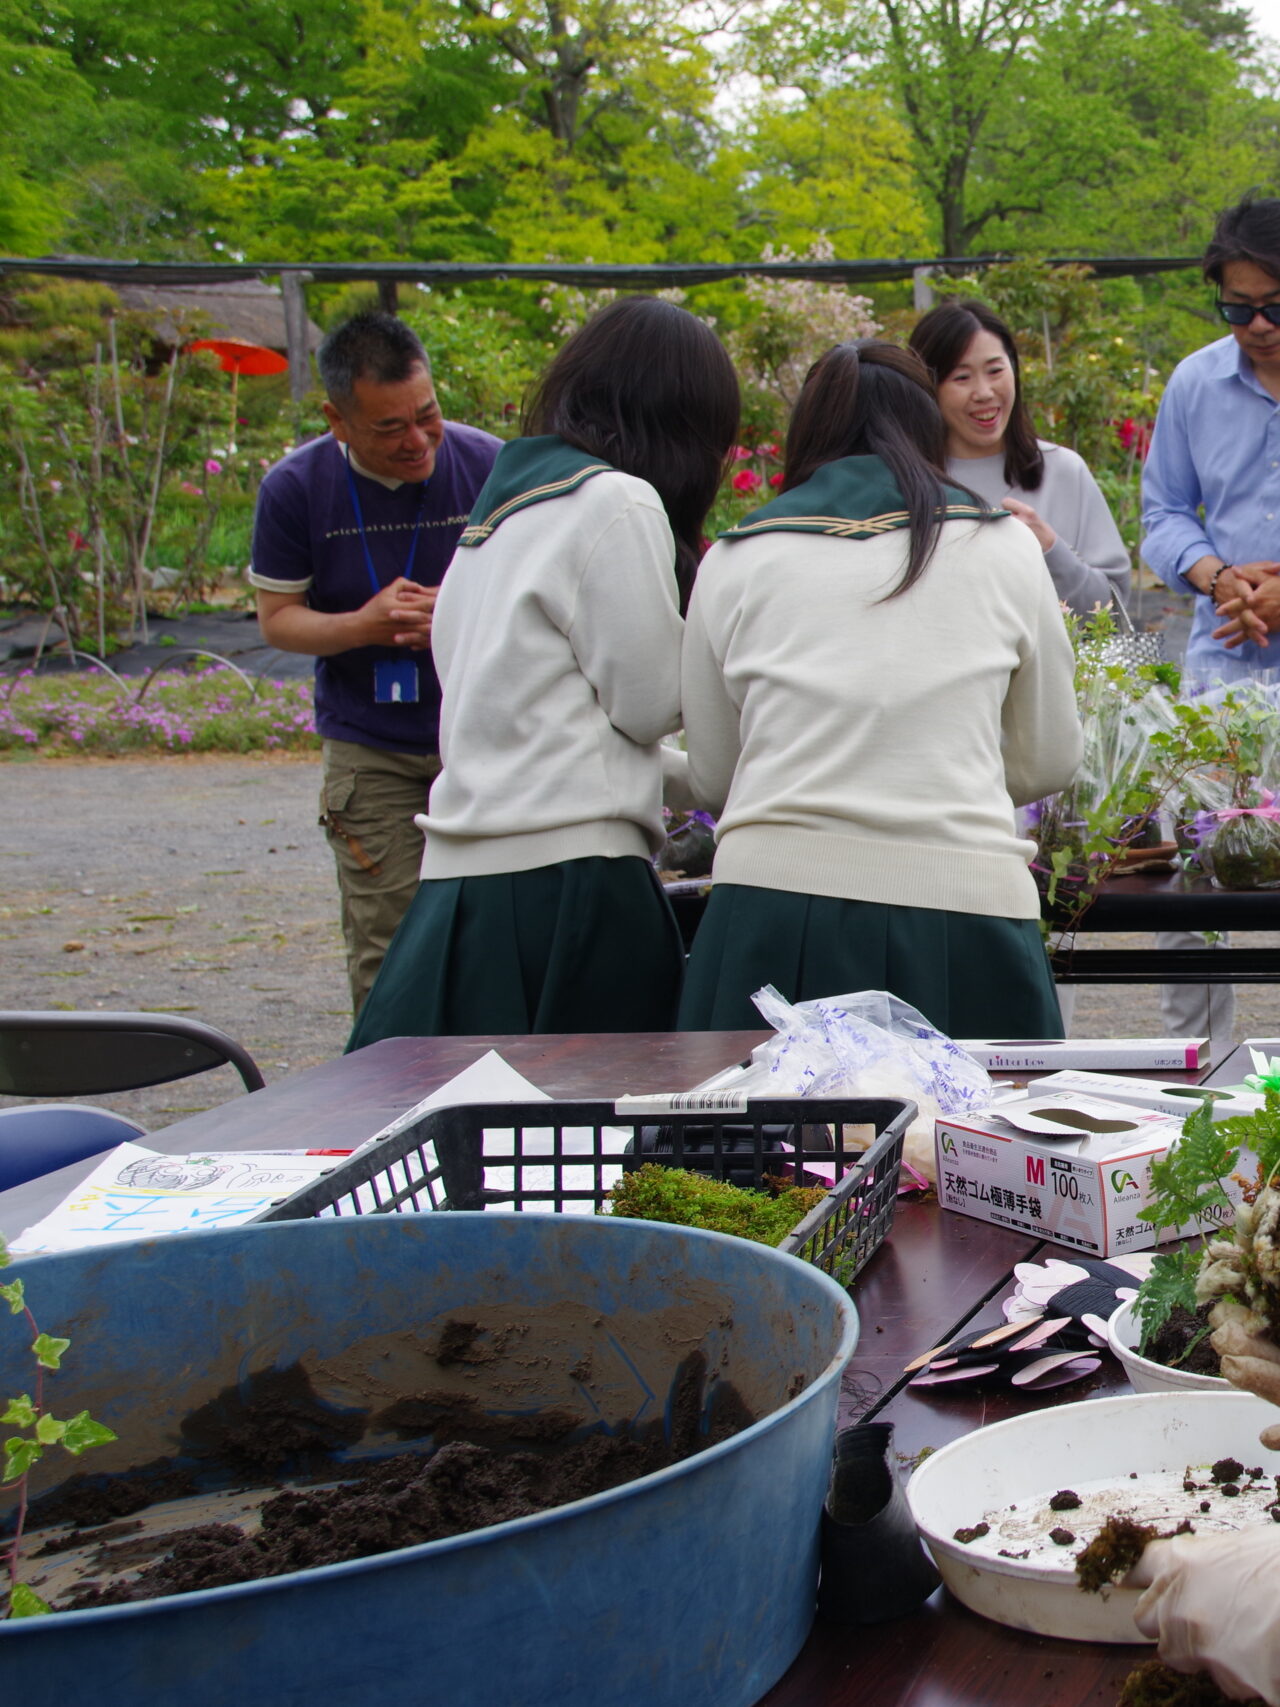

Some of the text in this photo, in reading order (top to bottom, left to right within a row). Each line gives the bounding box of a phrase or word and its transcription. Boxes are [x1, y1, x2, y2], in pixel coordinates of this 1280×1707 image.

[1026, 1155, 1045, 1186] M
[945, 1171, 1042, 1219] 天然ゴム極薄手袋
[1113, 1193, 1141, 1204] Alleanza
